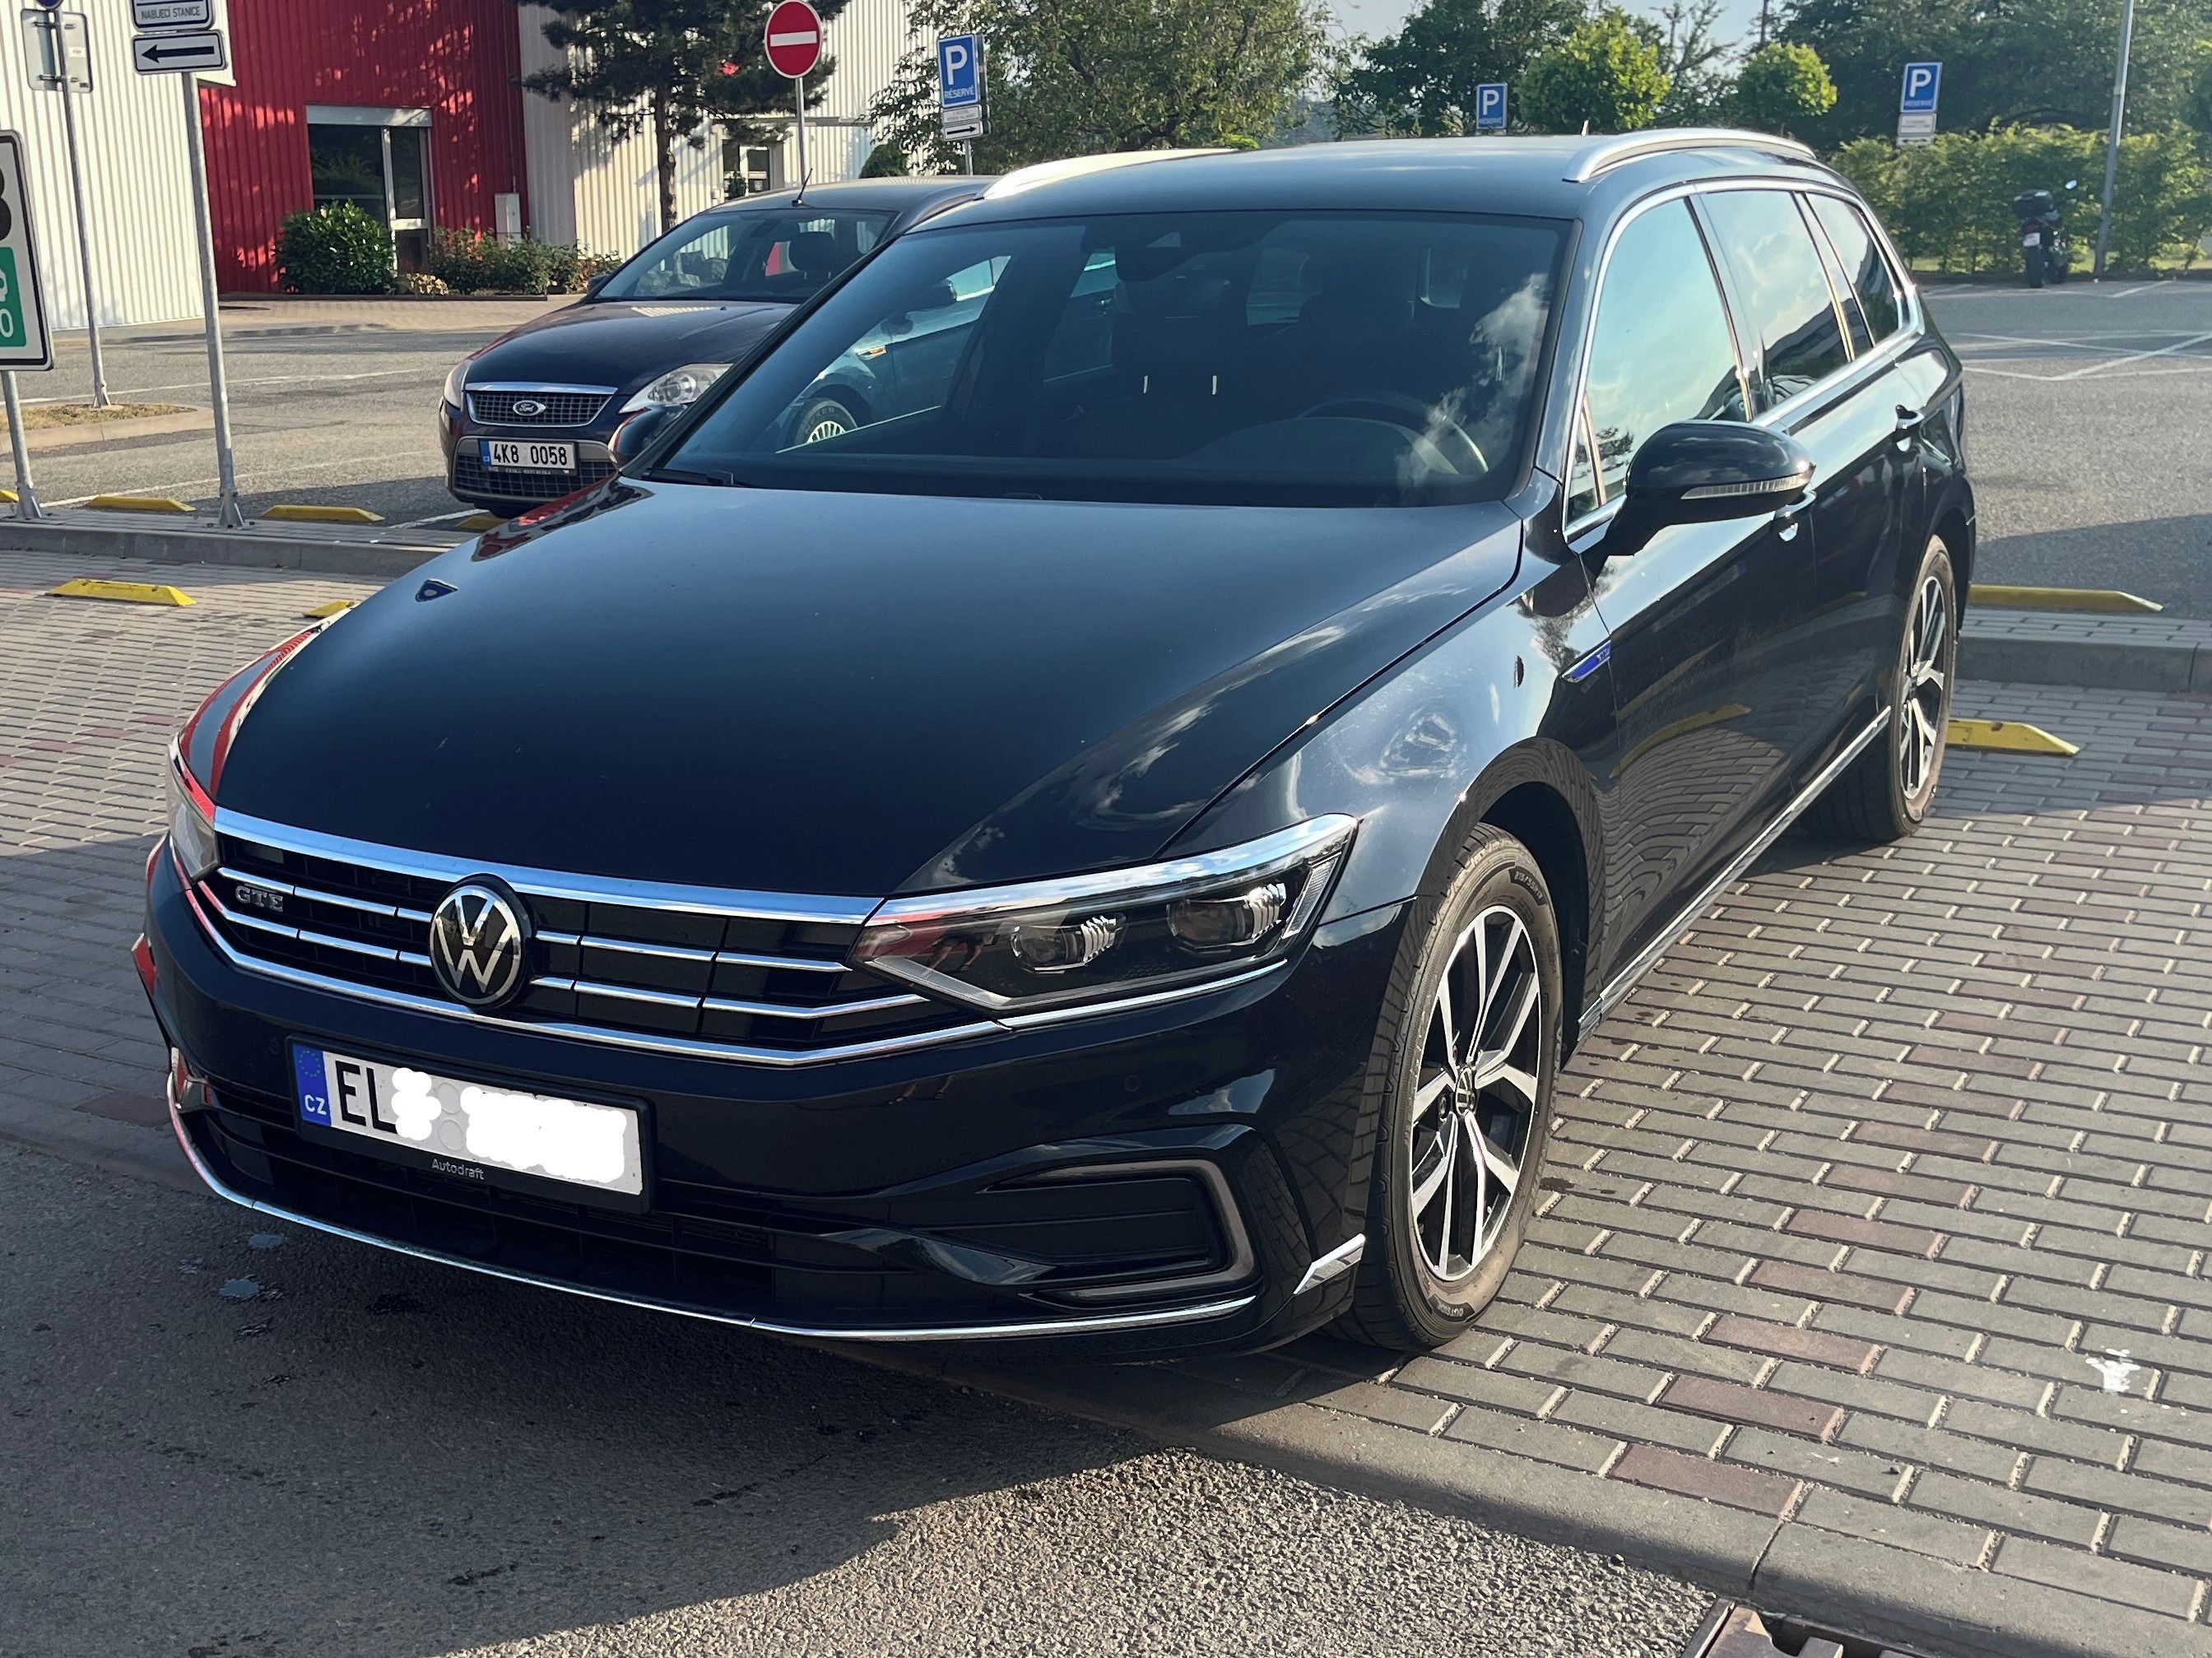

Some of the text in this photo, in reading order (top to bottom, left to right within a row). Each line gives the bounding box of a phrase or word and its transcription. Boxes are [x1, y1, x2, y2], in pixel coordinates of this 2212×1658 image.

[172, 7, 201, 17] STANICE
[945, 44, 968, 86] P
[1909, 68, 1931, 97] P
[1482, 89, 1499, 115] P
[494, 444, 568, 466] 4K8 0058
[433, 891, 516, 996] VW
[304, 1094, 327, 1116] CZ
[334, 1060, 411, 1136] EL
[432, 1158, 485, 1181] Autodraft
